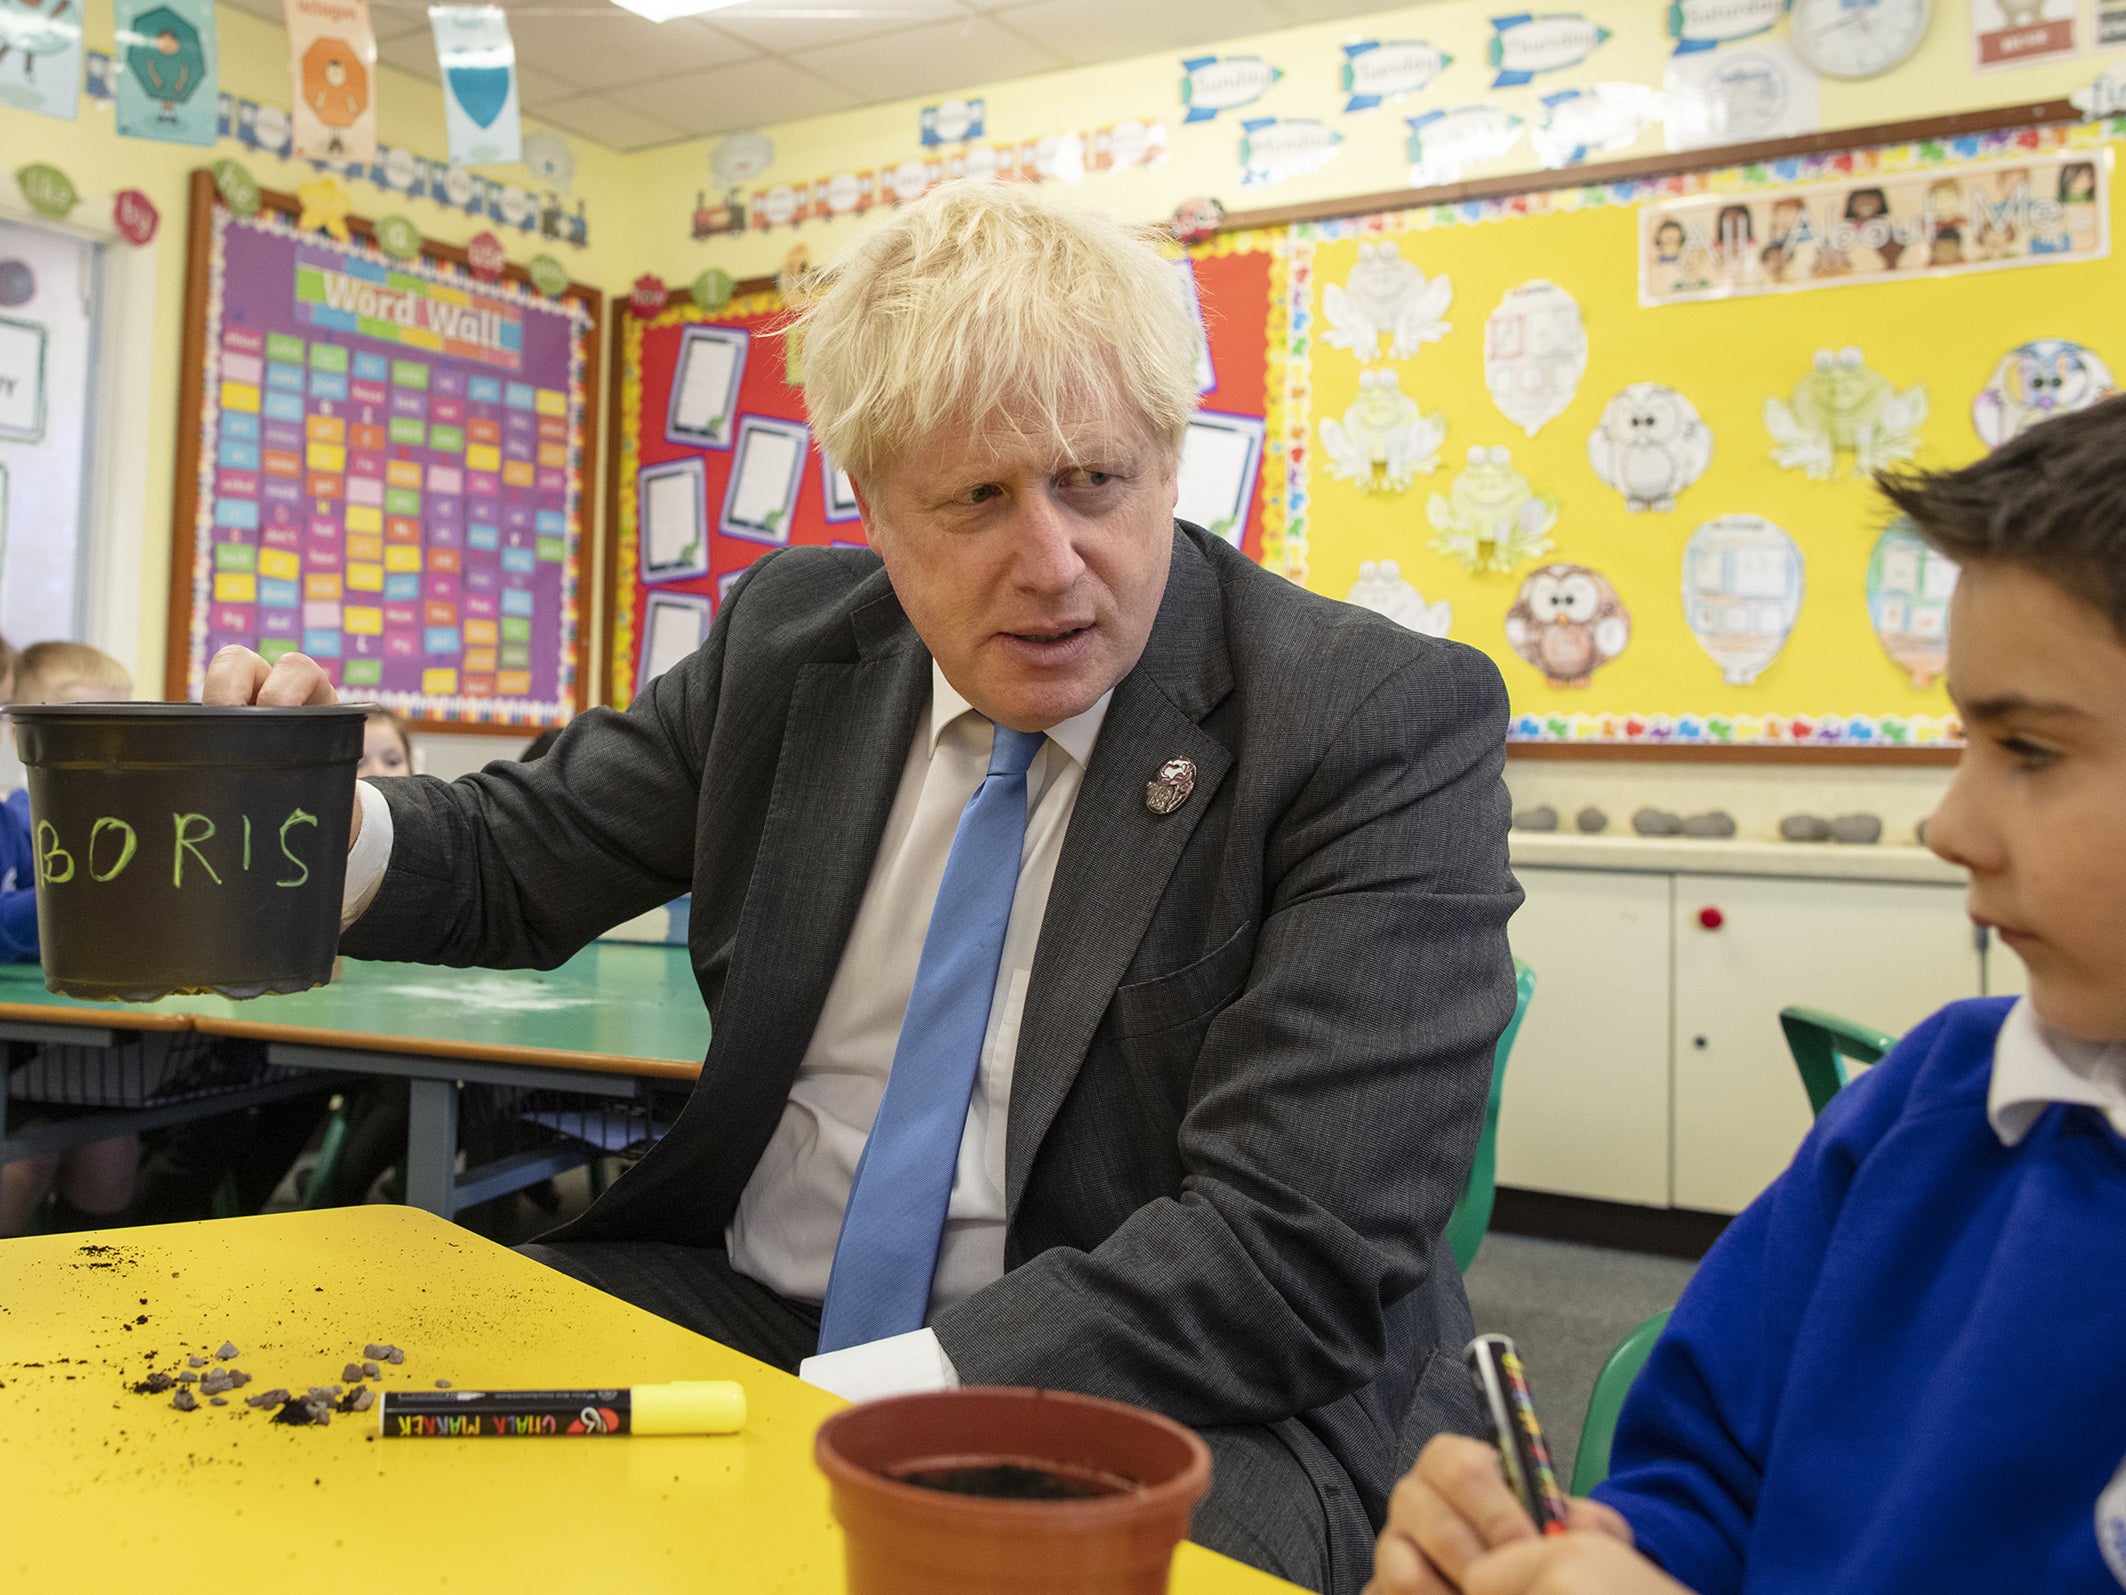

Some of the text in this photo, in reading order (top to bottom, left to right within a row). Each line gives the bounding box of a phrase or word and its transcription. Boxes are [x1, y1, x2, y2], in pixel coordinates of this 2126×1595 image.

[1676, 184, 2066, 270] All About Me
[322, 271, 500, 349] Word Wall
[37, 807, 319, 890] BORIS
[398, 1413, 557, 1437] CHALK MARKER
